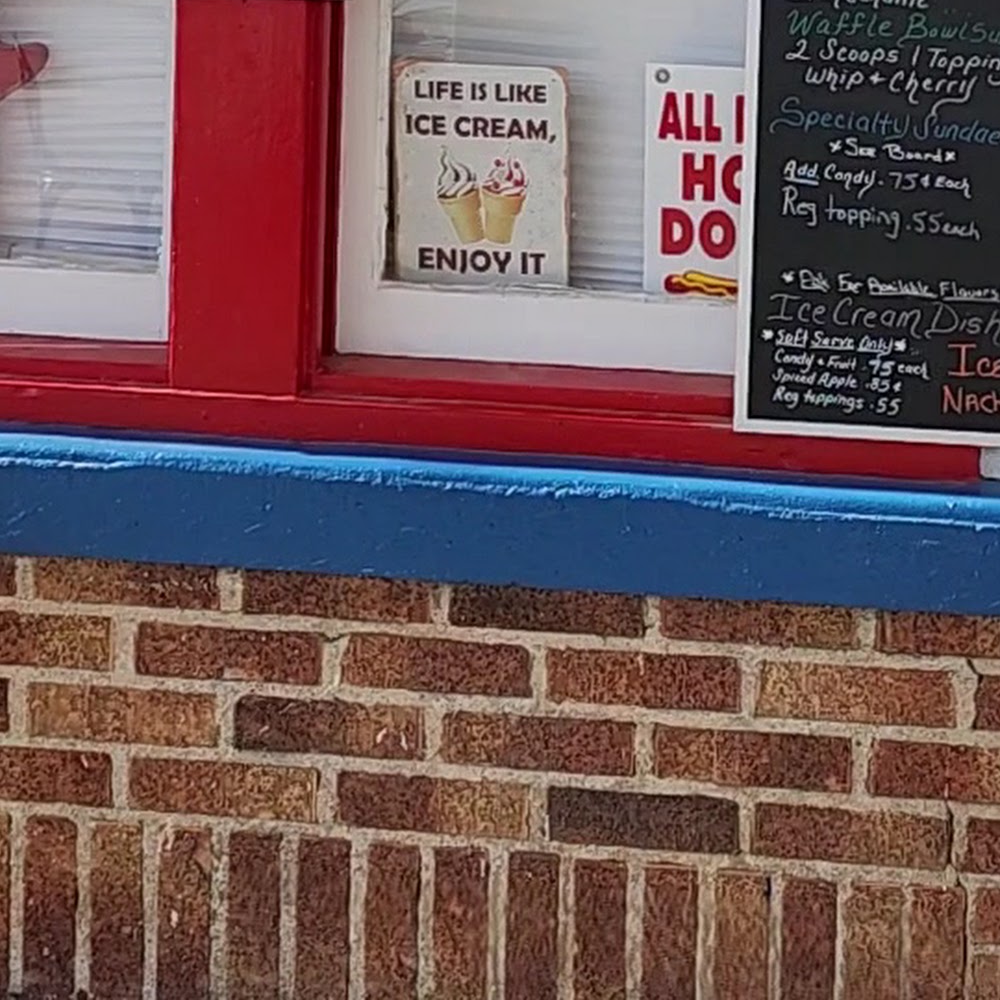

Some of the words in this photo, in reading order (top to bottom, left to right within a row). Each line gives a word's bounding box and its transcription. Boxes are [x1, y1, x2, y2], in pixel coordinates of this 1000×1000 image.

[787, 10, 894, 38] Waffle
[897, 13, 969, 46] Bowl
[784, 40, 810, 61] 2
[820, 39, 899, 65] Scoops
[414, 79, 463, 100] LIFE
[471, 82, 487, 100] IS
[494, 83, 547, 103] LIKE
[805, 67, 864, 92] Whip
[889, 71, 978, 116] Cherry
[405, 114, 447, 136] ICE
[454, 116, 557, 144] CREAM,
[659, 91, 722, 142] ALL
[770, 96, 912, 141] Specialty
[782, 186, 817, 226] Reg
[825, 195, 900, 239] topping
[417, 247, 513, 275] ENJOY
[520, 253, 546, 275] IT
[767, 294, 826, 324] Ice
[832, 298, 922, 339] Cream
[773, 386, 799, 409] Reg
